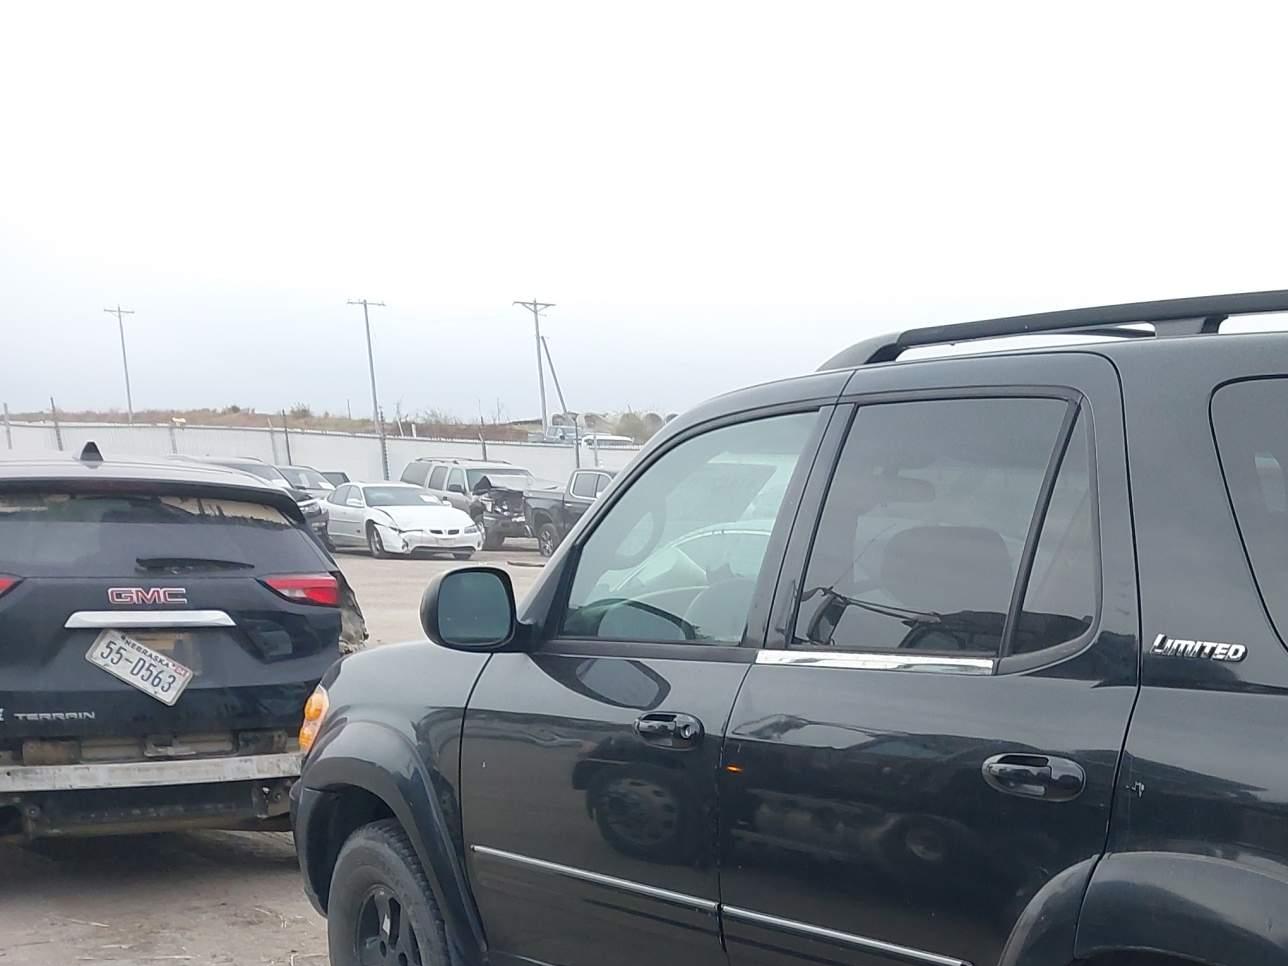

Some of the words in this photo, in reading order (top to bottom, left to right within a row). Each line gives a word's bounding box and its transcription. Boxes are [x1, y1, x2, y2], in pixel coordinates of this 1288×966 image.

[107, 587, 188, 605] GMC
[124, 639, 170, 668] NEBRASKA
[13, 712, 96, 720] TERRAIN
